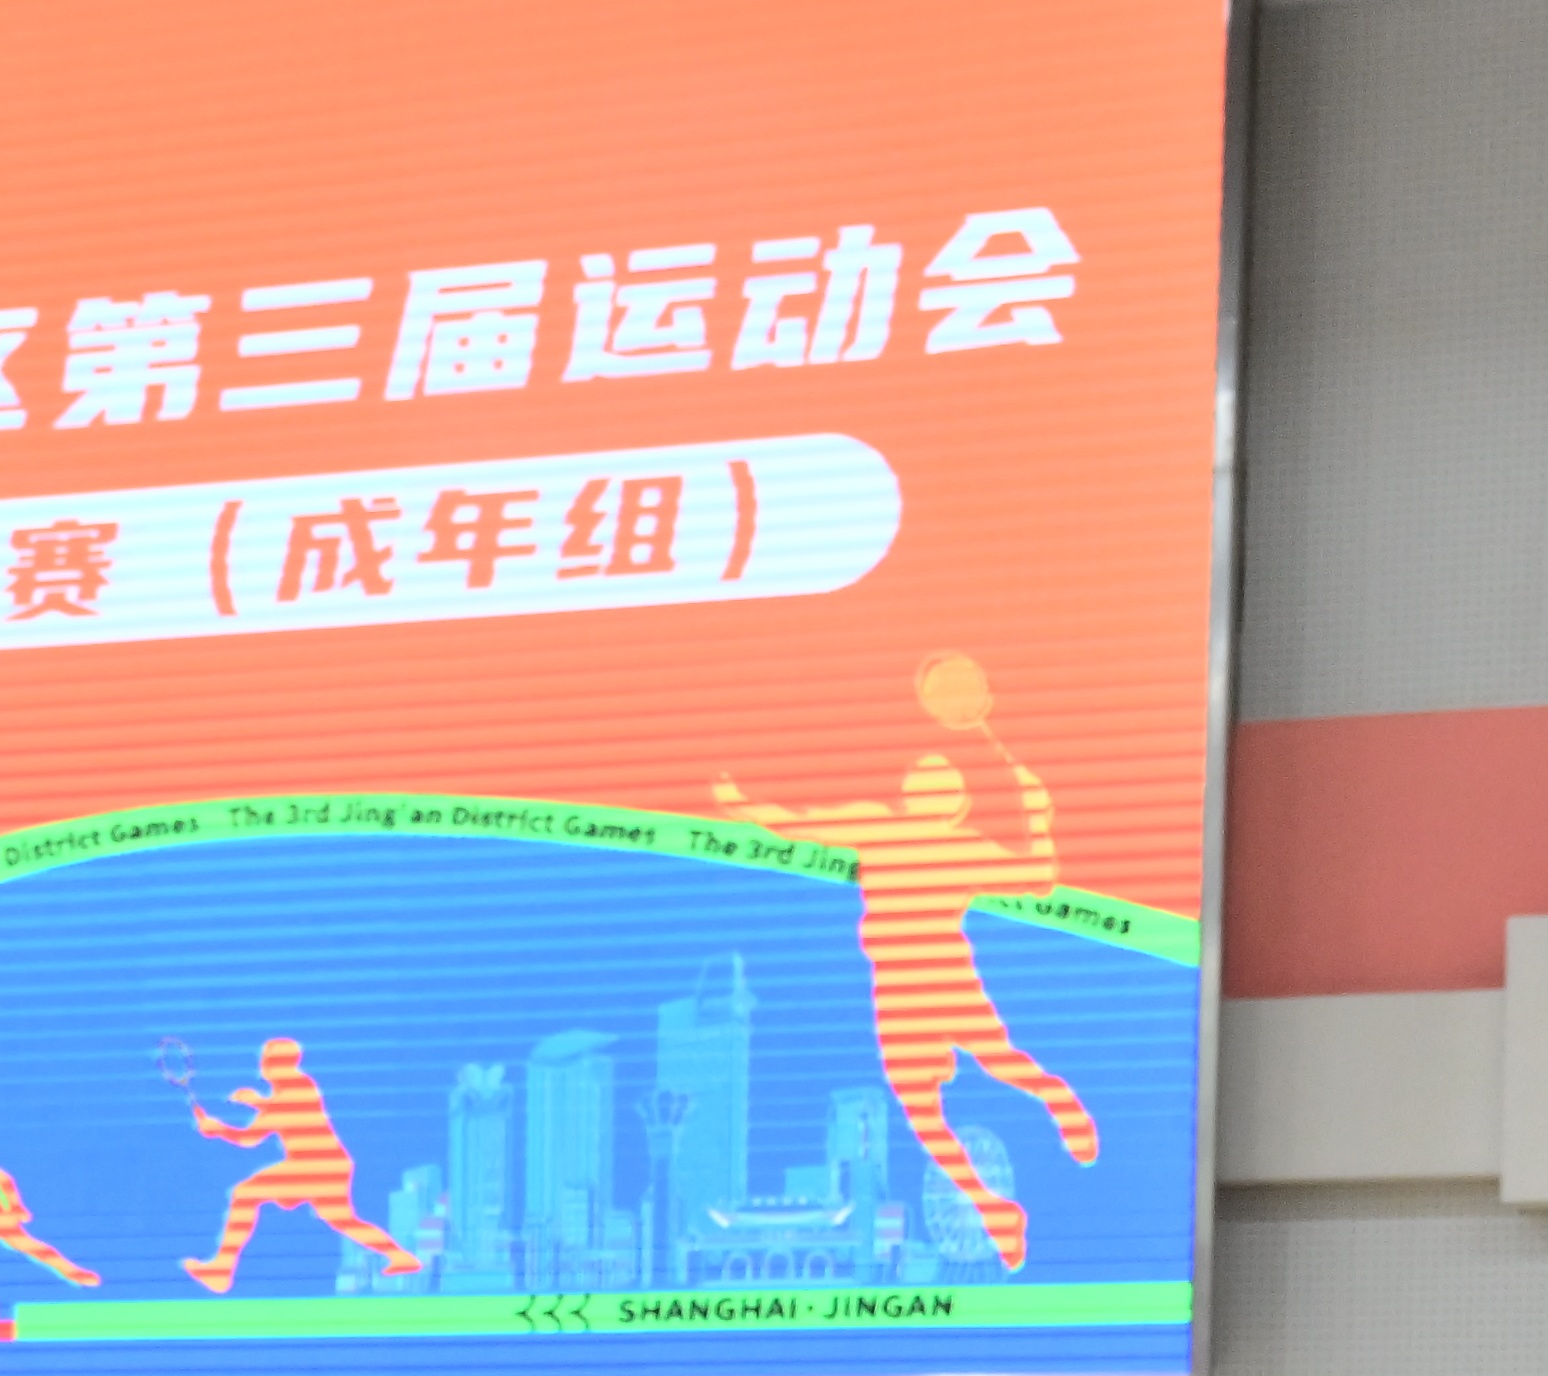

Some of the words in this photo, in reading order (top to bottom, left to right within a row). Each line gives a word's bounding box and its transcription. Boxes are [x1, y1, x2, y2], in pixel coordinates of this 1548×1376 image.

[4, 828, 101, 867] District
[110, 816, 200, 844] Games
[228, 804, 276, 828] The
[286, 802, 331, 826] 3rd
[452, 805, 554, 836] District
[563, 814, 657, 846] Games
[688, 830, 738, 858] The
[746, 838, 795, 867] 3rd
[618, 1296, 797, 1324] SHANGHAI
[823, 1293, 954, 1321] JINGAN
